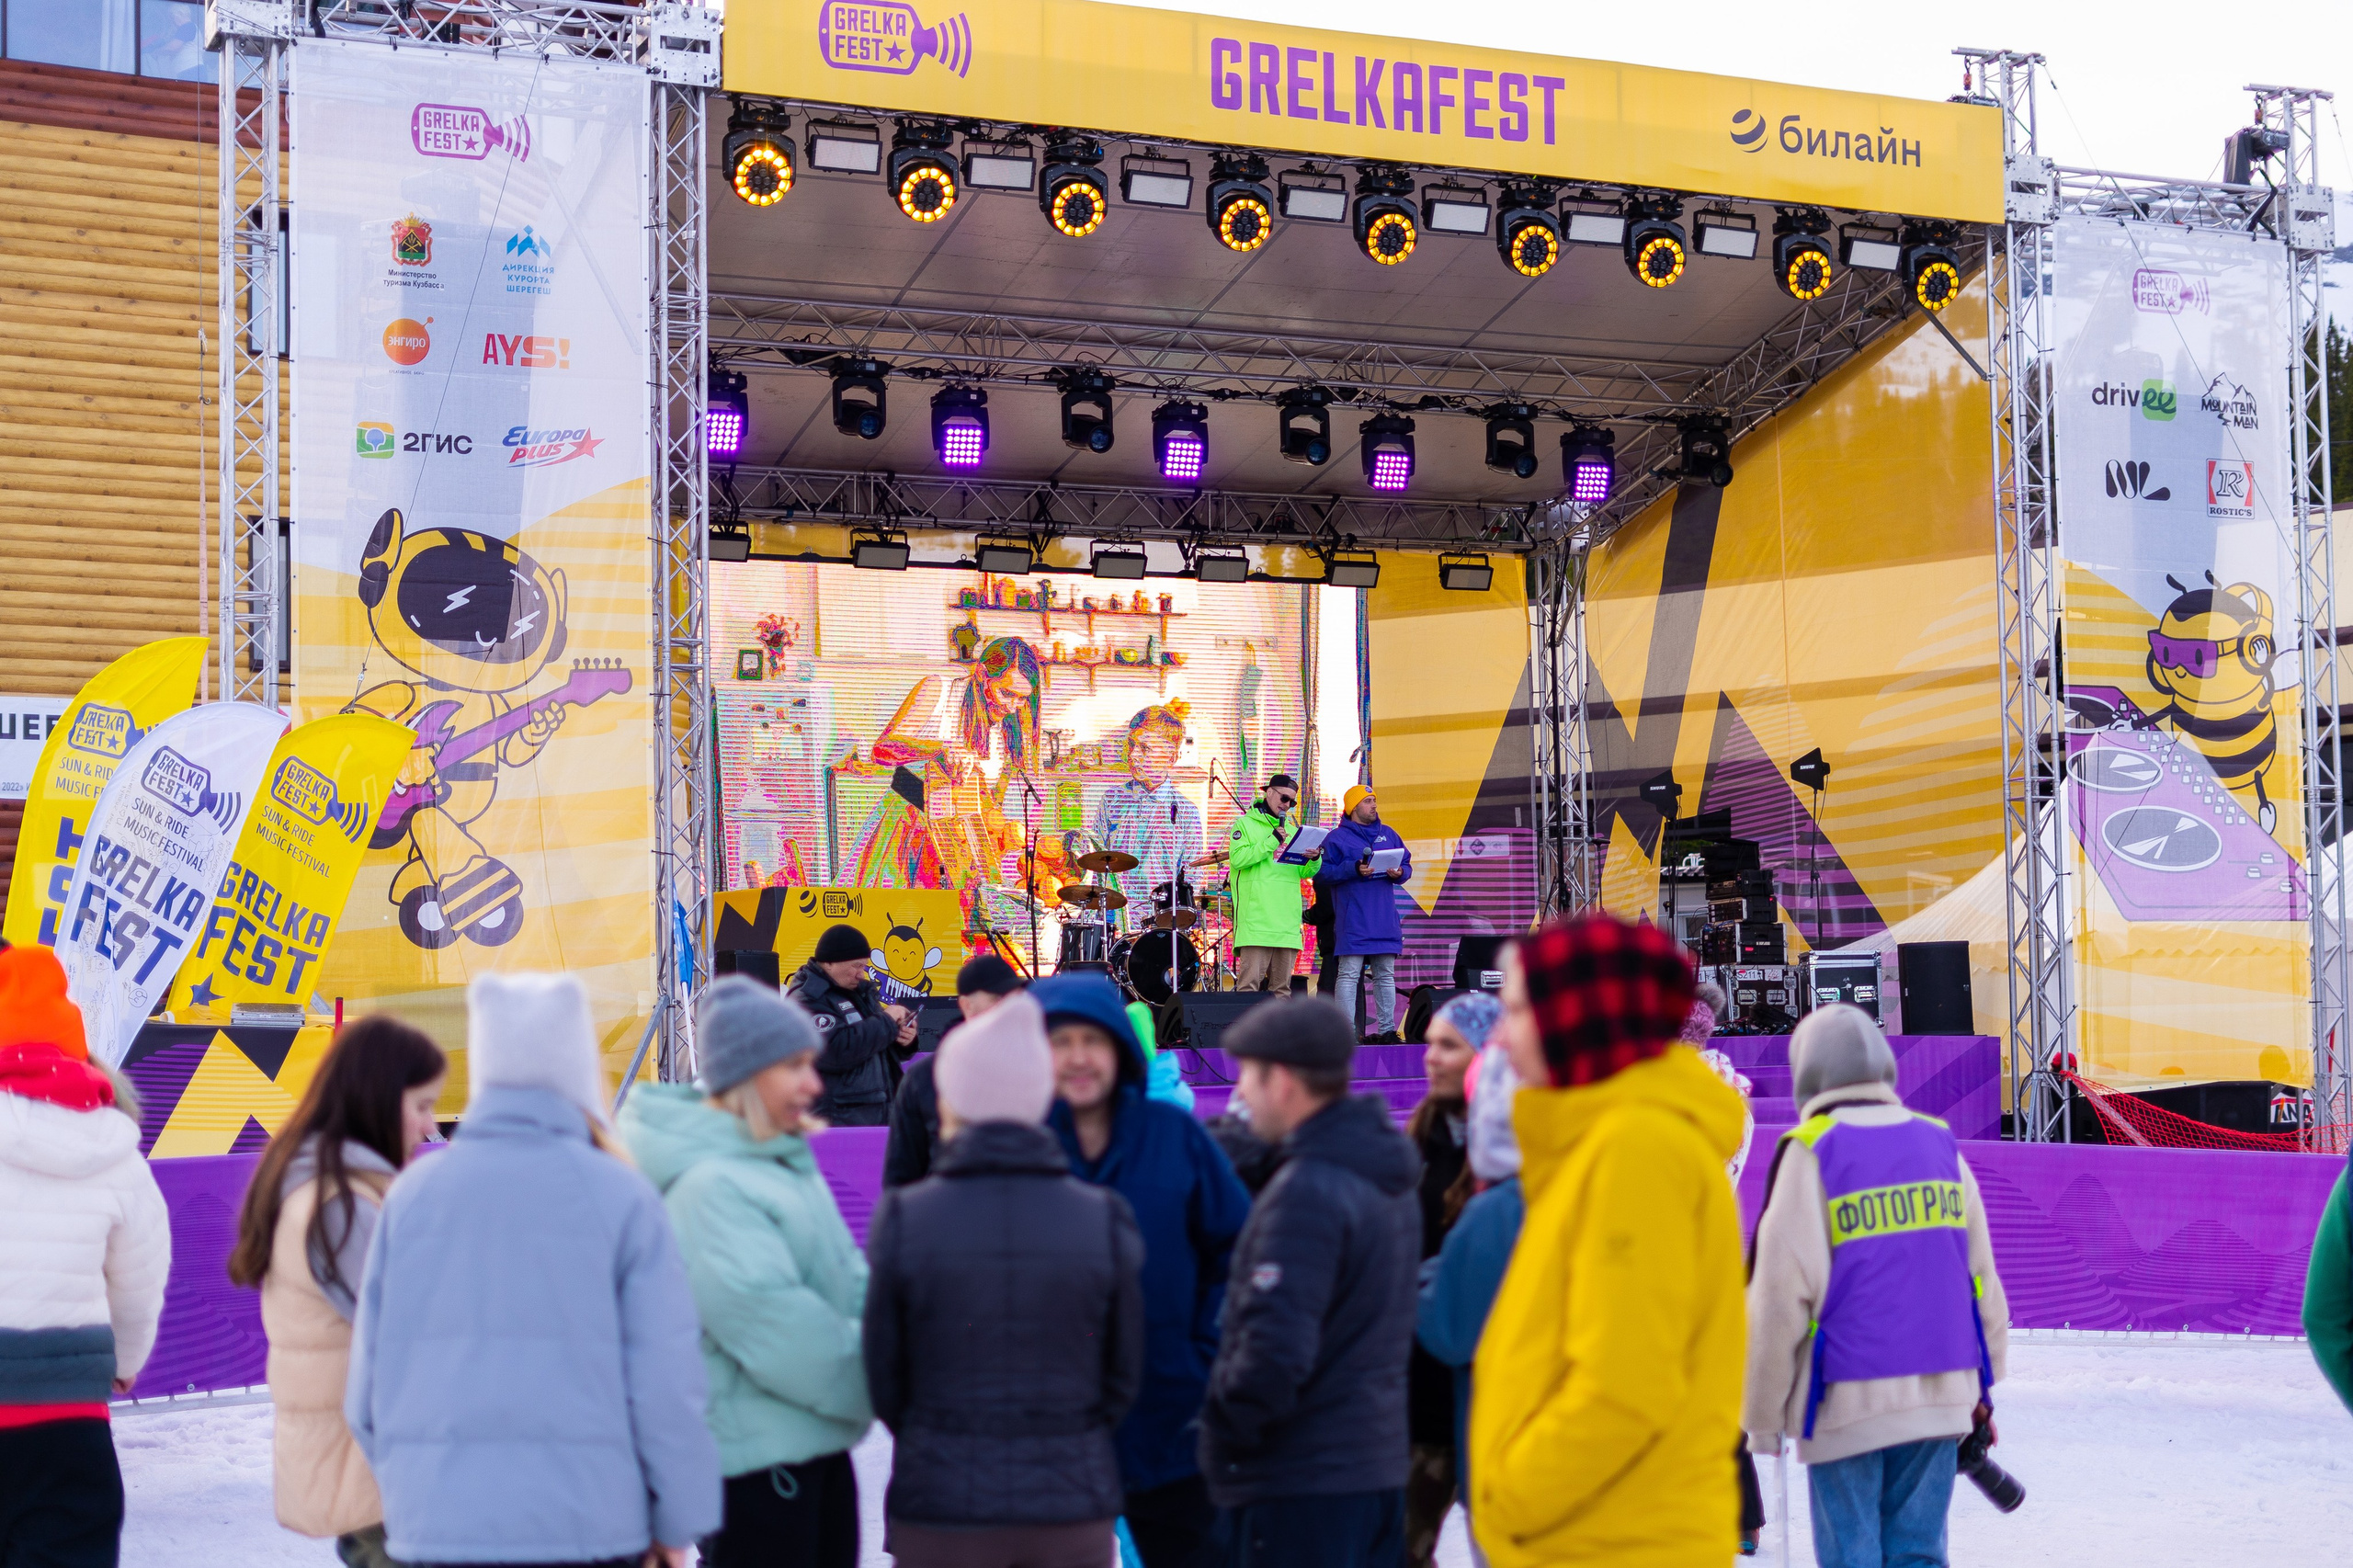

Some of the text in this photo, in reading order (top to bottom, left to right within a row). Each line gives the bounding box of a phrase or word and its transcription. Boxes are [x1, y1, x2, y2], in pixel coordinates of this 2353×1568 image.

[835, 7, 906, 37] GRELKA
[835, 34, 883, 62] FEST
[1211, 37, 1565, 145] GRELKAFEST
[423, 110, 480, 131] GRELKA
[424, 131, 461, 151] FEST
[1779, 115, 1921, 167] билайн
[388, 268, 437, 279] Министерство
[502, 263, 555, 274] ДИРЕКЦИЯ
[507, 274, 551, 284] КУРОРТА
[382, 278, 445, 290] туризма Кузбасса
[506, 284, 551, 295] ШЕРЕГЕШ
[2141, 275, 2178, 291] GRELKA
[2141, 291, 2165, 307] FEST
[388, 335, 426, 350] энгиро
[483, 333, 570, 369] AYS!
[2092, 381, 2177, 414] drivee
[2201, 398, 2257, 415] MOUNTAIN
[2234, 415, 2258, 430] MAN
[403, 432, 472, 455] 2ГИС
[2209, 506, 2253, 517] ROSTIC'S
[59, 756, 83, 775] SUN
[84, 763, 92, 777] &
[157, 754, 205, 791] GRELKA
[55, 776, 91, 798] MUSIC
[148, 770, 184, 801] FEST
[278, 779, 311, 809] FEST
[286, 763, 331, 801] GRELKA
[131, 797, 190, 840] SUN & RIDE
[262, 805, 316, 847] SUN & RIDE
[123, 816, 160, 845] MUSIC
[158, 835, 205, 873] FESTIVAL
[256, 823, 331, 879] MUSIC FESTIVAL
[89, 834, 206, 933] GRELKA
[217, 860, 332, 948] GRELKA
[825, 894, 847, 904] GRELKA
[826, 904, 840, 915] FEST
[196, 904, 319, 994] FEST
[1836, 1183, 1963, 1234] ФОТОГРАФ
